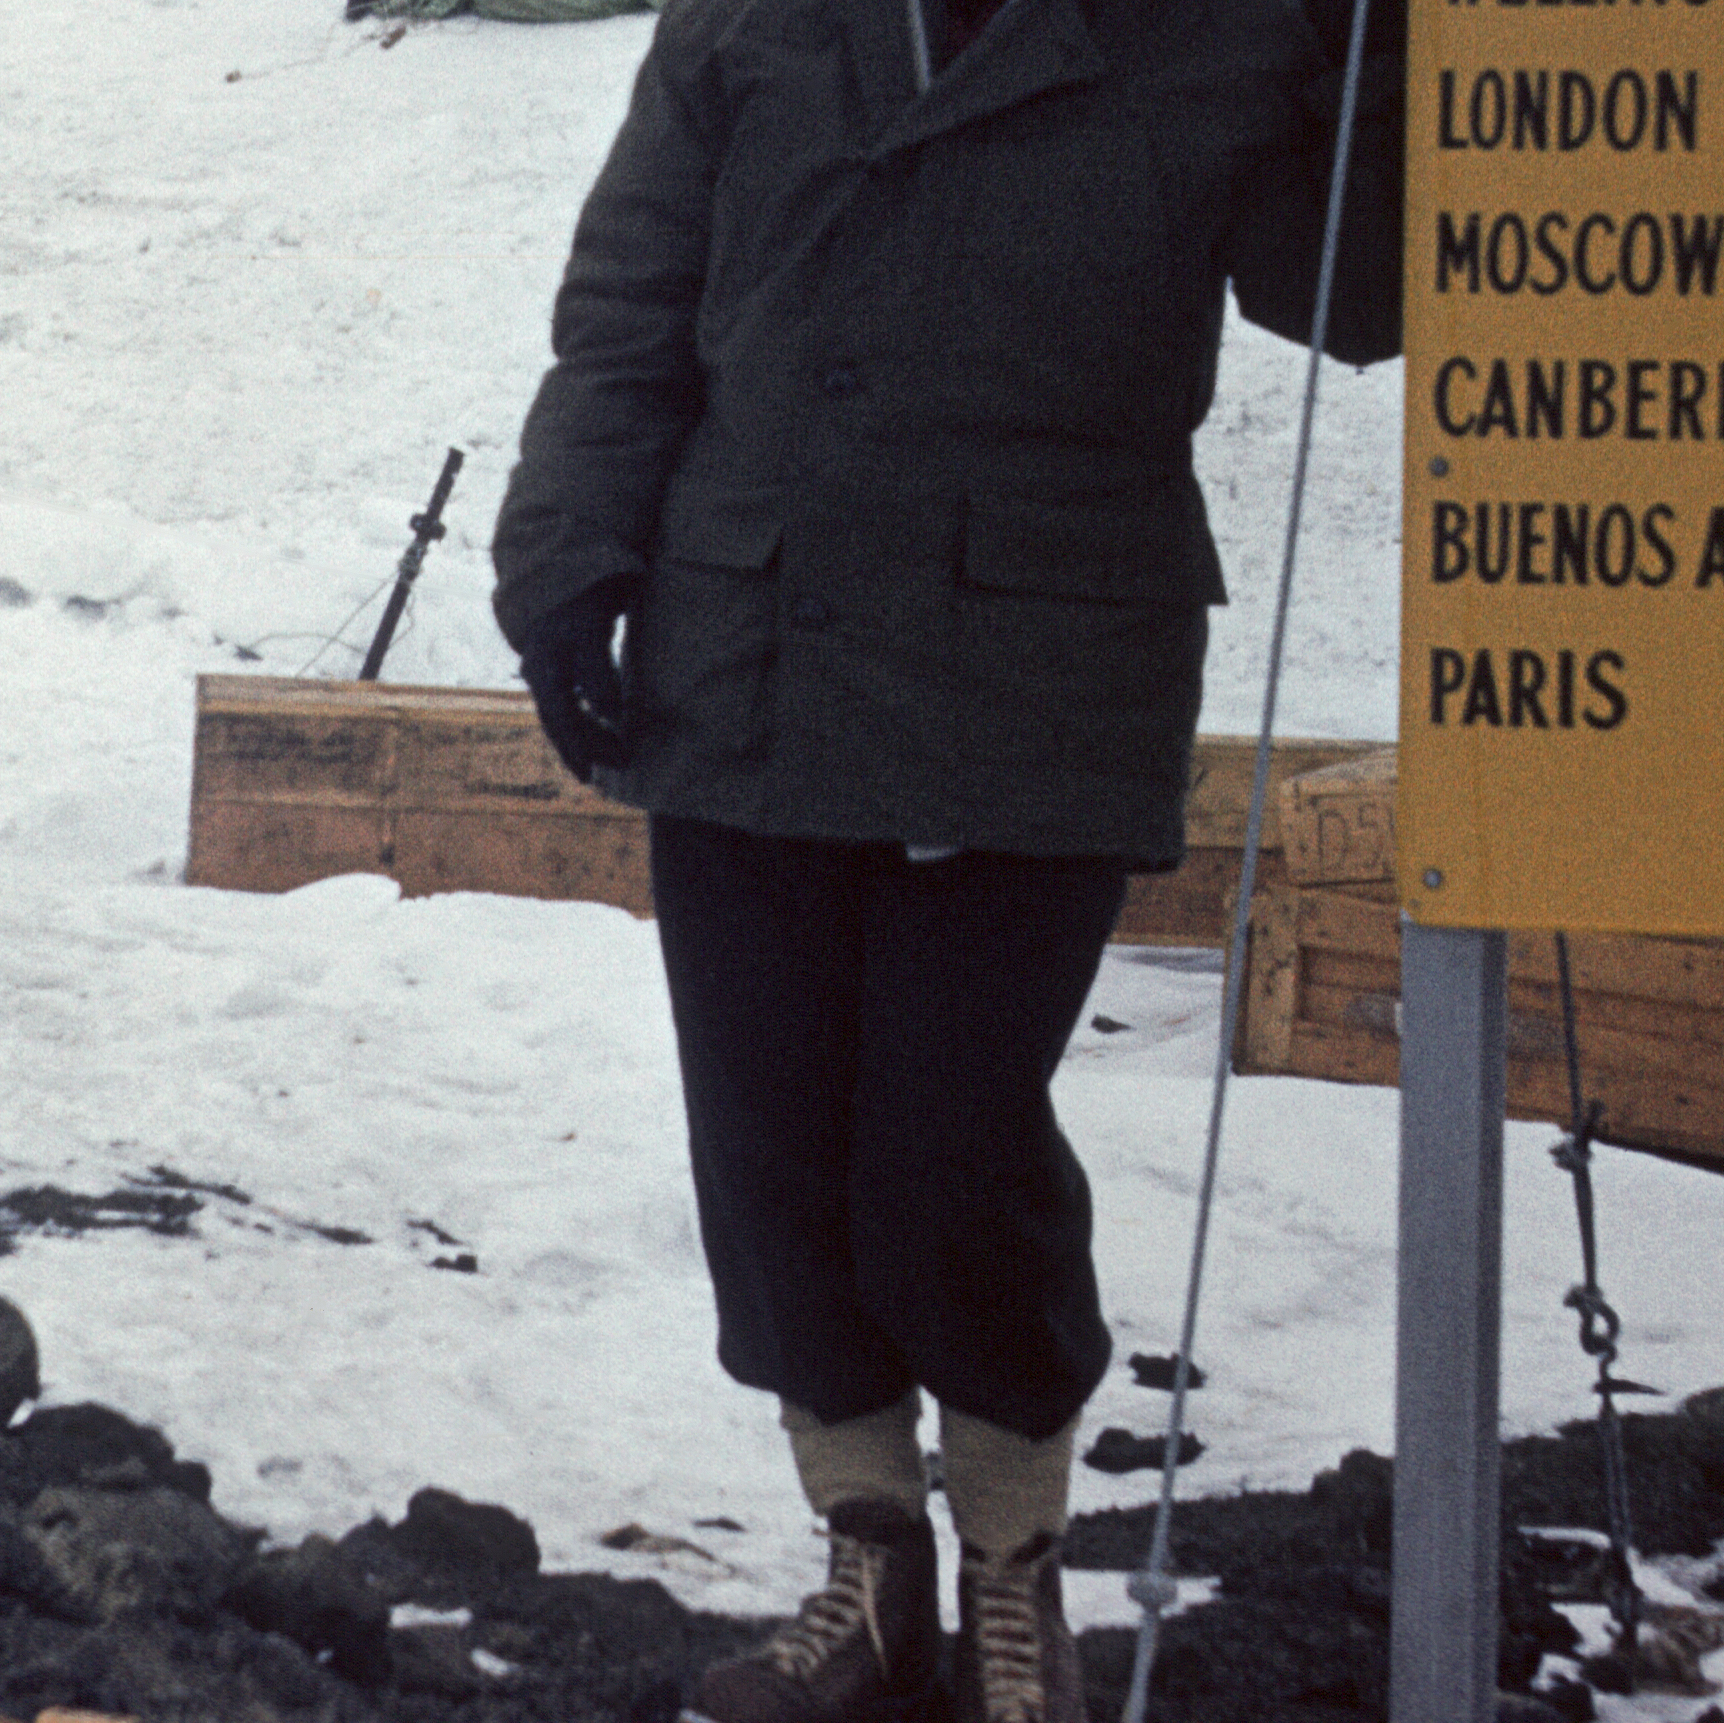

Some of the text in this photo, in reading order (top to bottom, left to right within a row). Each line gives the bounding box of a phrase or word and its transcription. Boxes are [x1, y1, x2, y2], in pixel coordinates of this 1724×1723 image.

[1438, 68, 1700, 153] LONDON
[1431, 500, 1678, 589] BUENOS
[1430, 647, 1629, 732] PARIS
